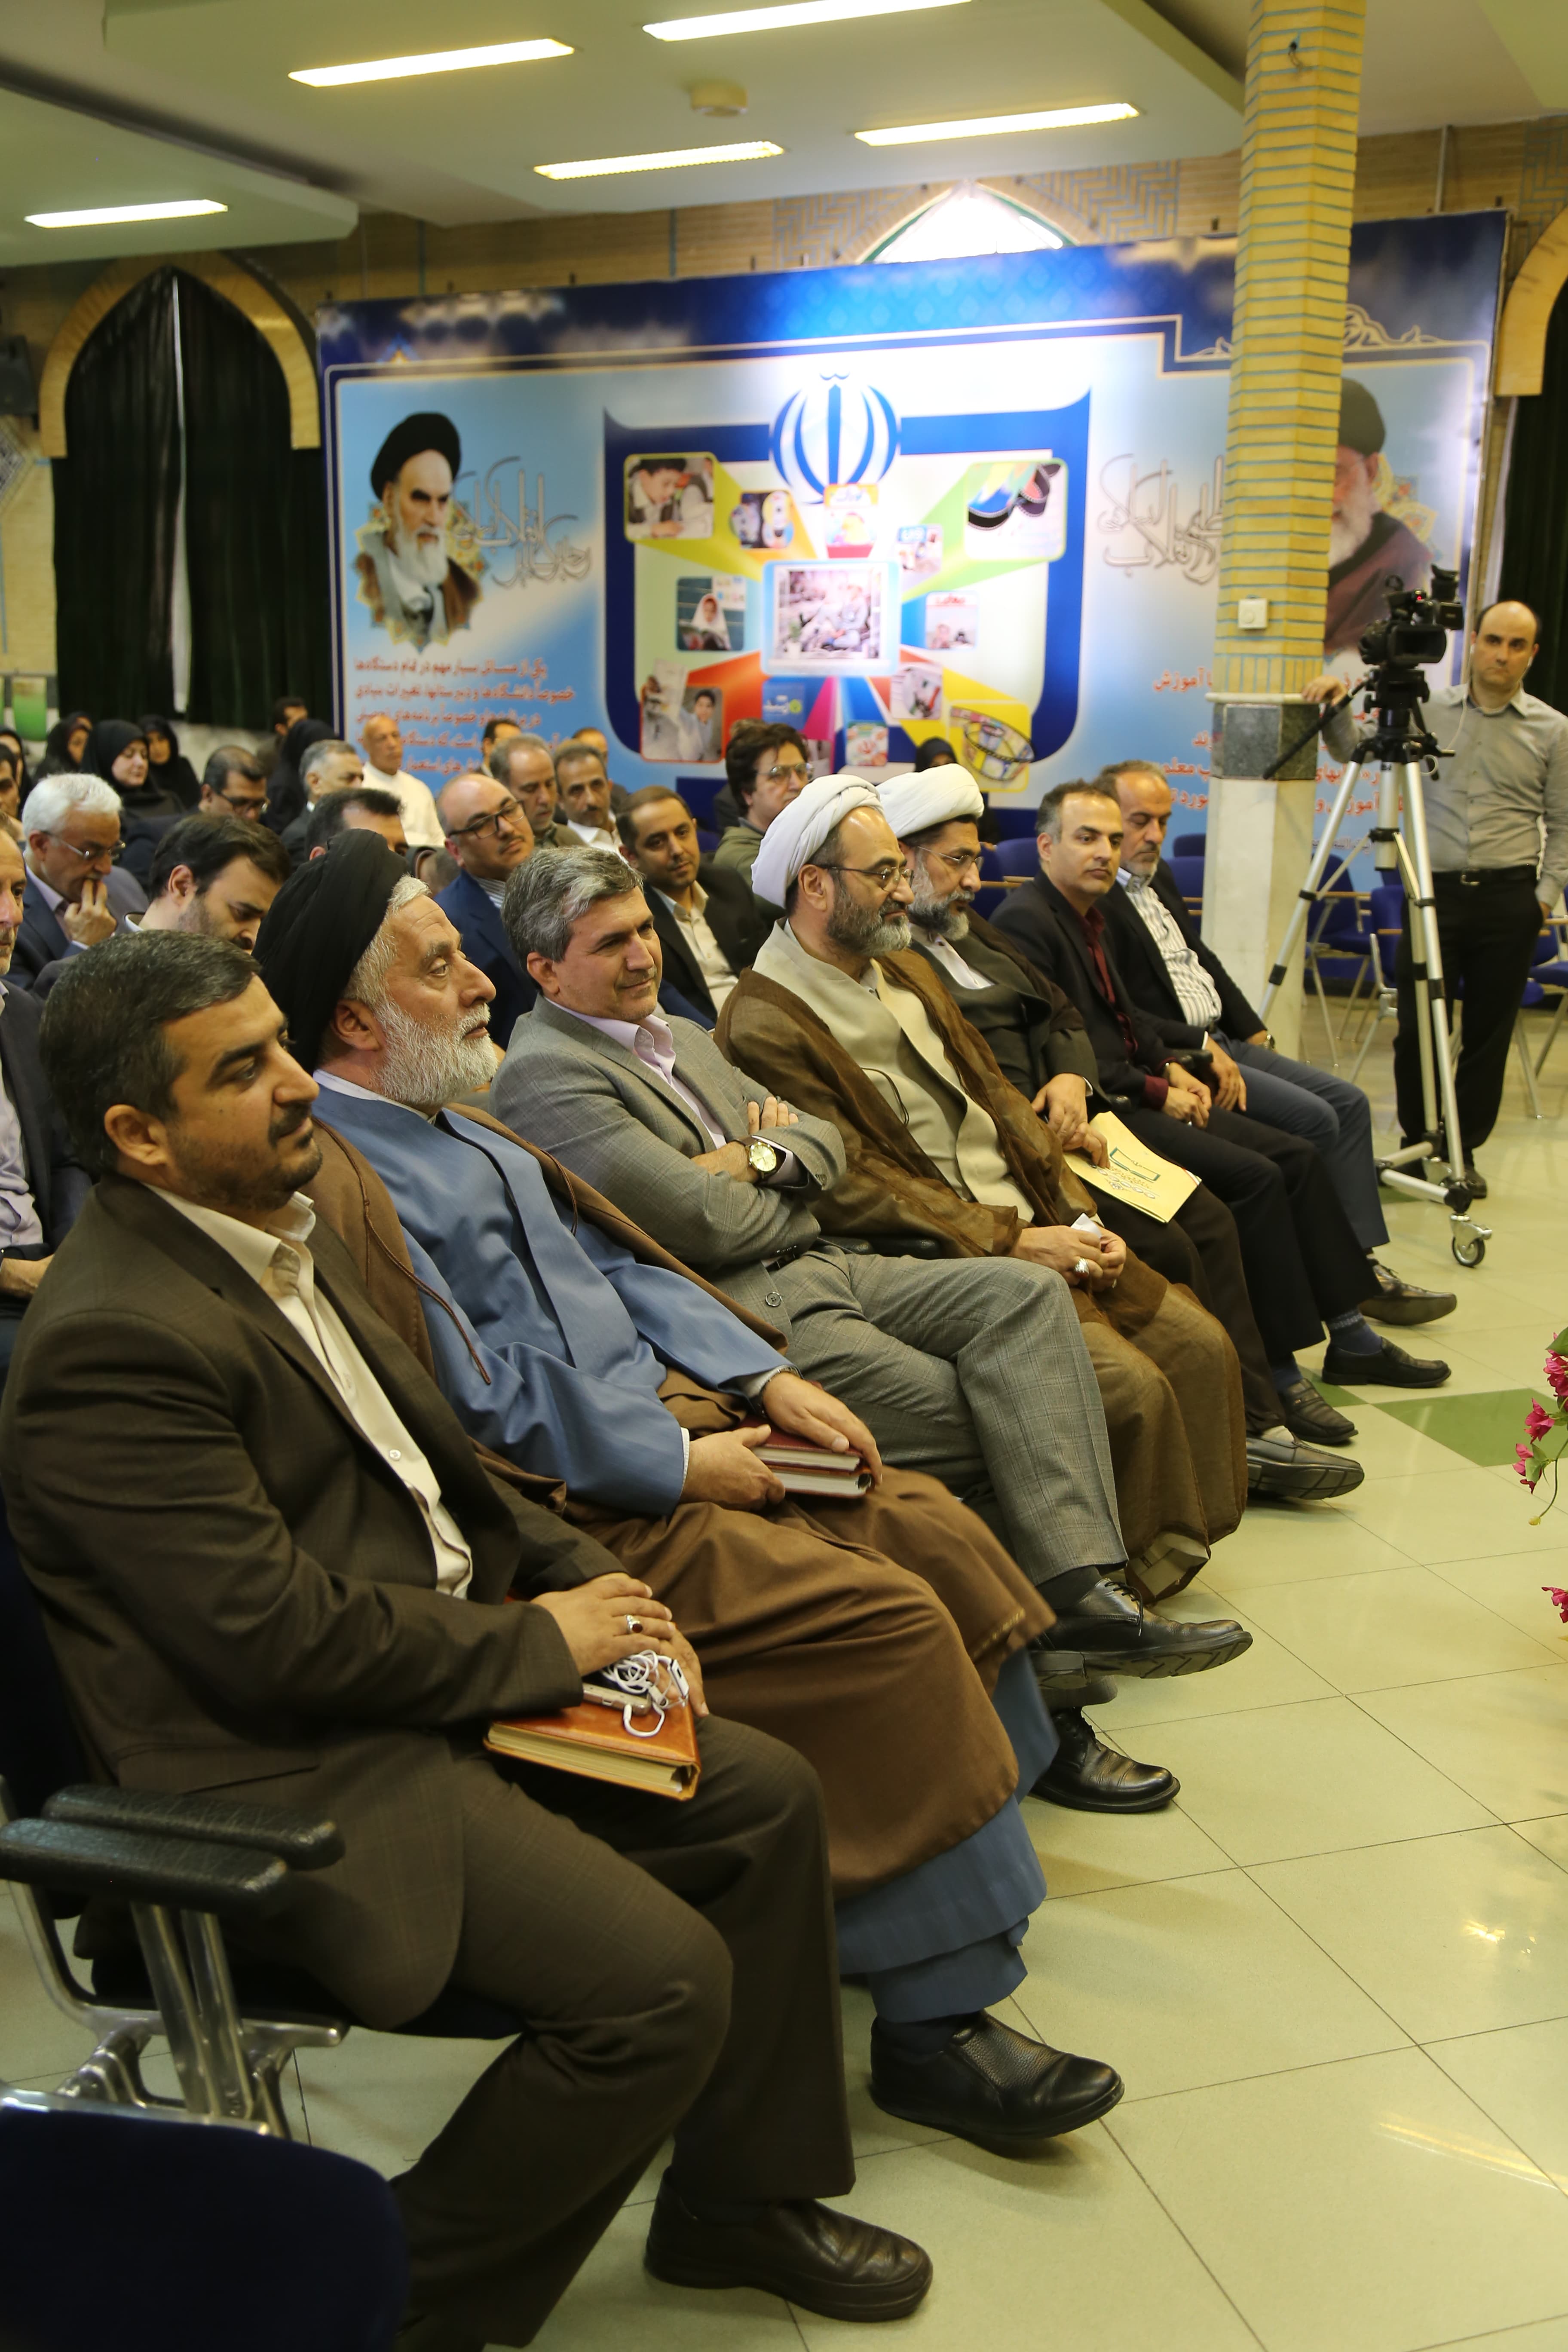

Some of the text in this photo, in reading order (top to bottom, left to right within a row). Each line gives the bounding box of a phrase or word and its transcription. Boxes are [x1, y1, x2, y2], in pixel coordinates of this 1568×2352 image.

[432, 663, 451, 677] مهم
[1152, 666, 1205, 693] آموزش
[472, 689, 479, 702] و
